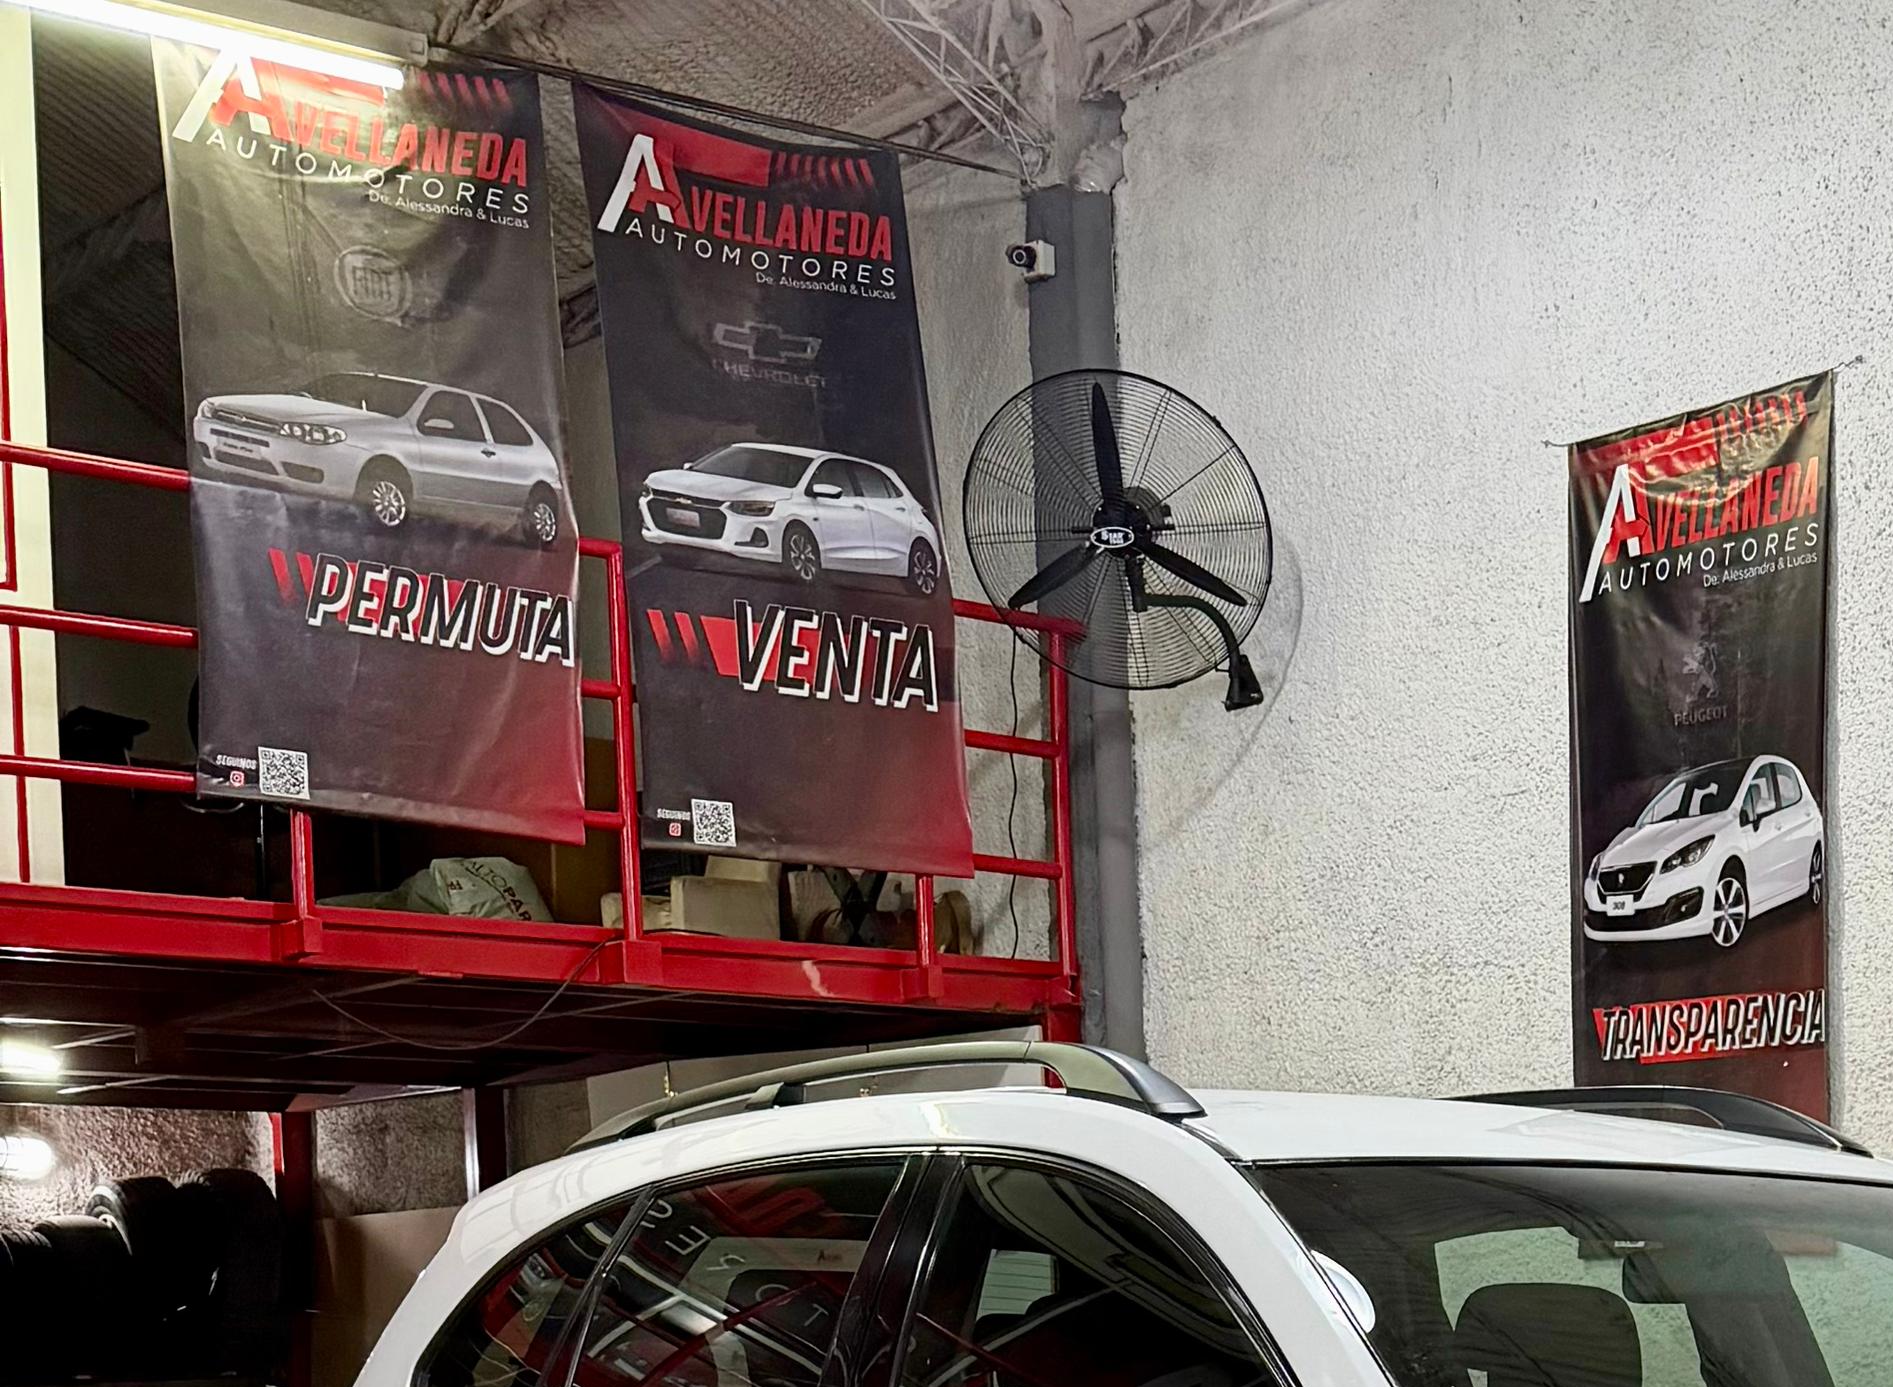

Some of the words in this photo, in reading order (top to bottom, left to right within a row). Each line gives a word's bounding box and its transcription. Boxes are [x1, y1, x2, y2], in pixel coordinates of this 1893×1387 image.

[172, 46, 528, 188] AVELLANEDA
[206, 127, 530, 214] AUTOMOTORES
[597, 132, 894, 262] AVELLANEDA
[394, 196, 474, 218] Alessandra
[475, 207, 487, 221] &
[489, 210, 530, 229] Lucas
[624, 217, 896, 287] AUTOMOTORES
[779, 276, 848, 294] Alessandra
[849, 283, 859, 295] &
[860, 285, 897, 300] Lucas
[1578, 455, 1819, 604] AVELLANEDA
[1598, 522, 1819, 595] AUTOMOTORES
[1721, 561, 1776, 584] Alessandra
[1777, 557, 1785, 571] &
[1786, 551, 1818, 568] Lucas
[306, 552, 576, 667] PERMUTA
[733, 599, 939, 712] VENTA
[1674, 705, 1729, 727] PEUGEOT
[1601, 987, 1825, 1062] TRANSPARENCIA
